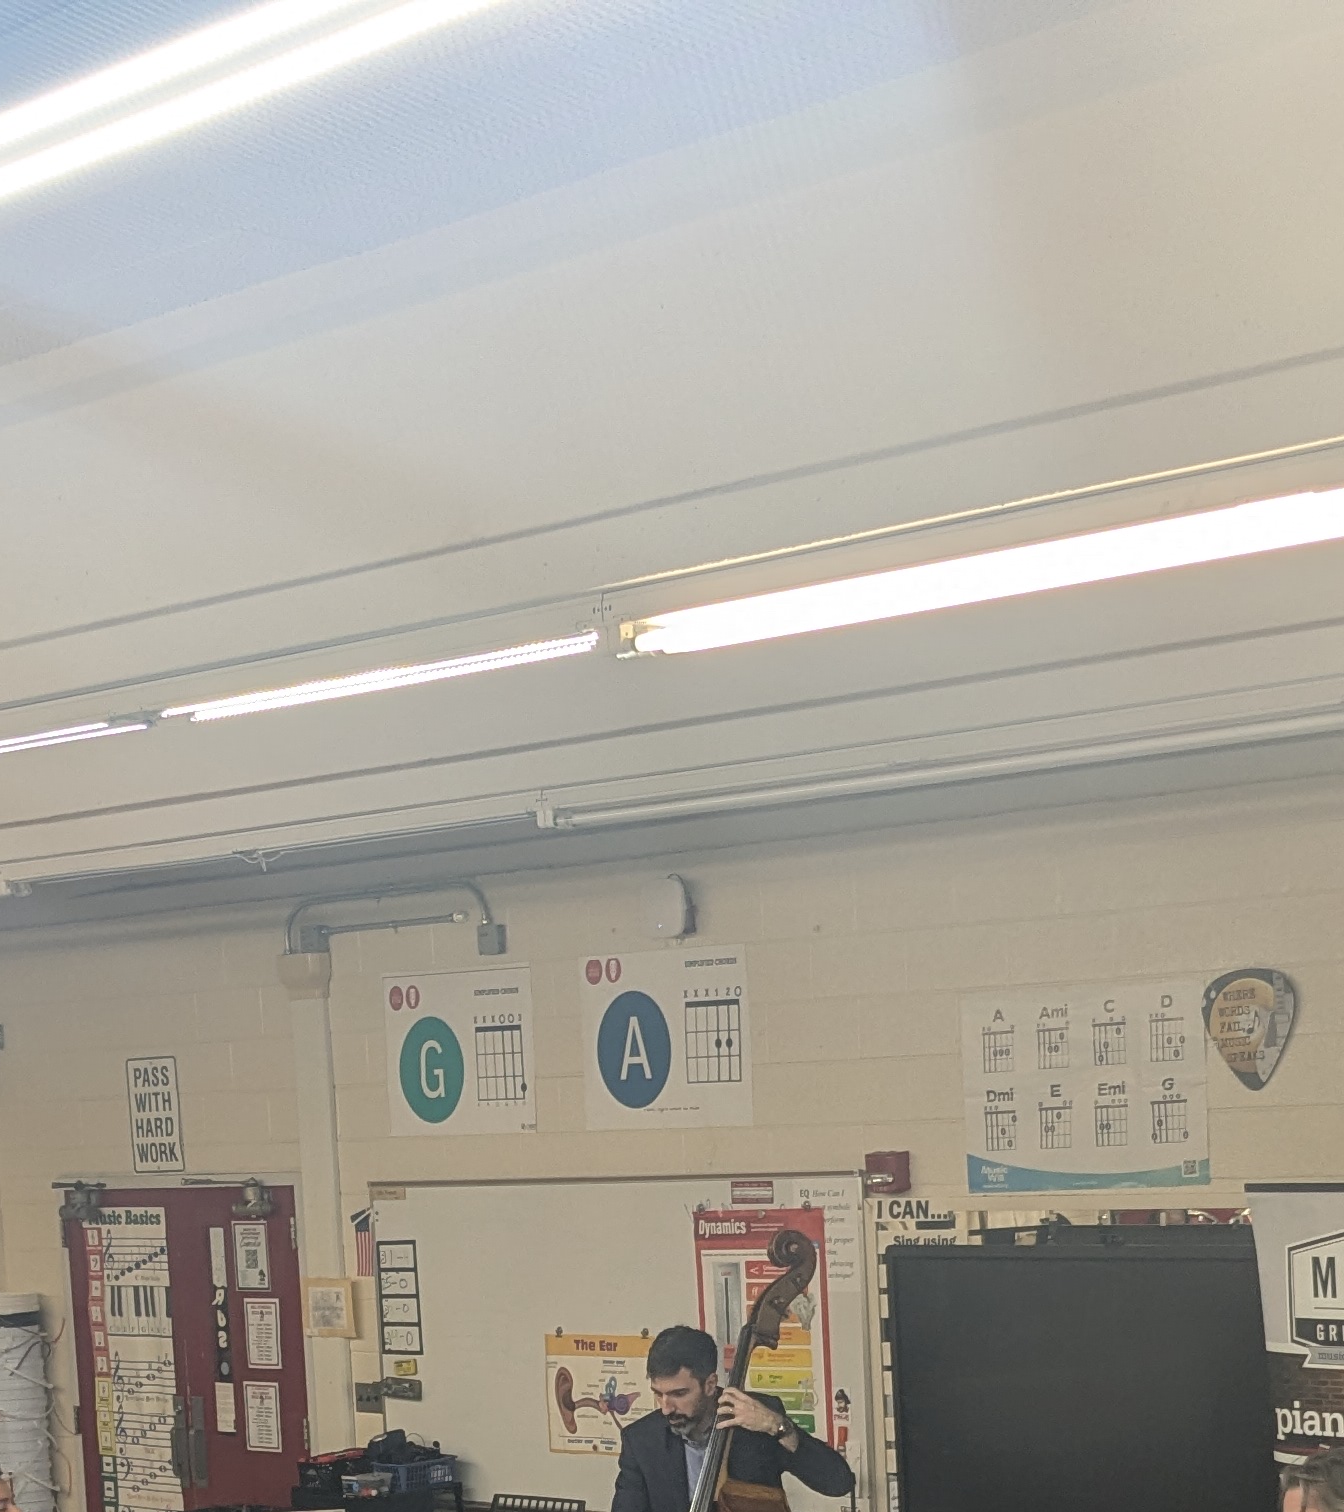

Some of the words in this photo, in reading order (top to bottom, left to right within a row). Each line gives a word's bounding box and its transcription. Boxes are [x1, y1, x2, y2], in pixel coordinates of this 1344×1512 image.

[1222, 988, 1256, 1002] WHERE
[993, 1009, 1005, 1022] A
[1038, 1004, 1068, 1020] Ami
[1103, 999, 1115, 1013] C
[1160, 995, 1173, 1008] D
[1218, 1005, 1250, 1017] WORDS
[620, 1015, 653, 1080] A
[1220, 1035, 1251, 1048] MUSIC
[1226, 1050, 1265, 1063] SPEAKS
[133, 1065, 170, 1088] PASS
[420, 1039, 446, 1099] G
[986, 1087, 1014, 1103] Dmi
[1050, 1084, 1062, 1098] E
[1097, 1081, 1126, 1096] Emi
[1161, 1077, 1175, 1091] G
[135, 1091, 172, 1113] WITH
[135, 1117, 174, 1138] HARD
[136, 1141, 179, 1163] WORK
[124, 1210, 162, 1226] Basics
[877, 1200, 883, 1219] I
[698, 1219, 747, 1238] Dynamics
[893, 1235, 920, 1245] Sing
[923, 1234, 957, 1245] using
[573, 1339, 596, 1351] The
[599, 1340, 618, 1352] Ear
